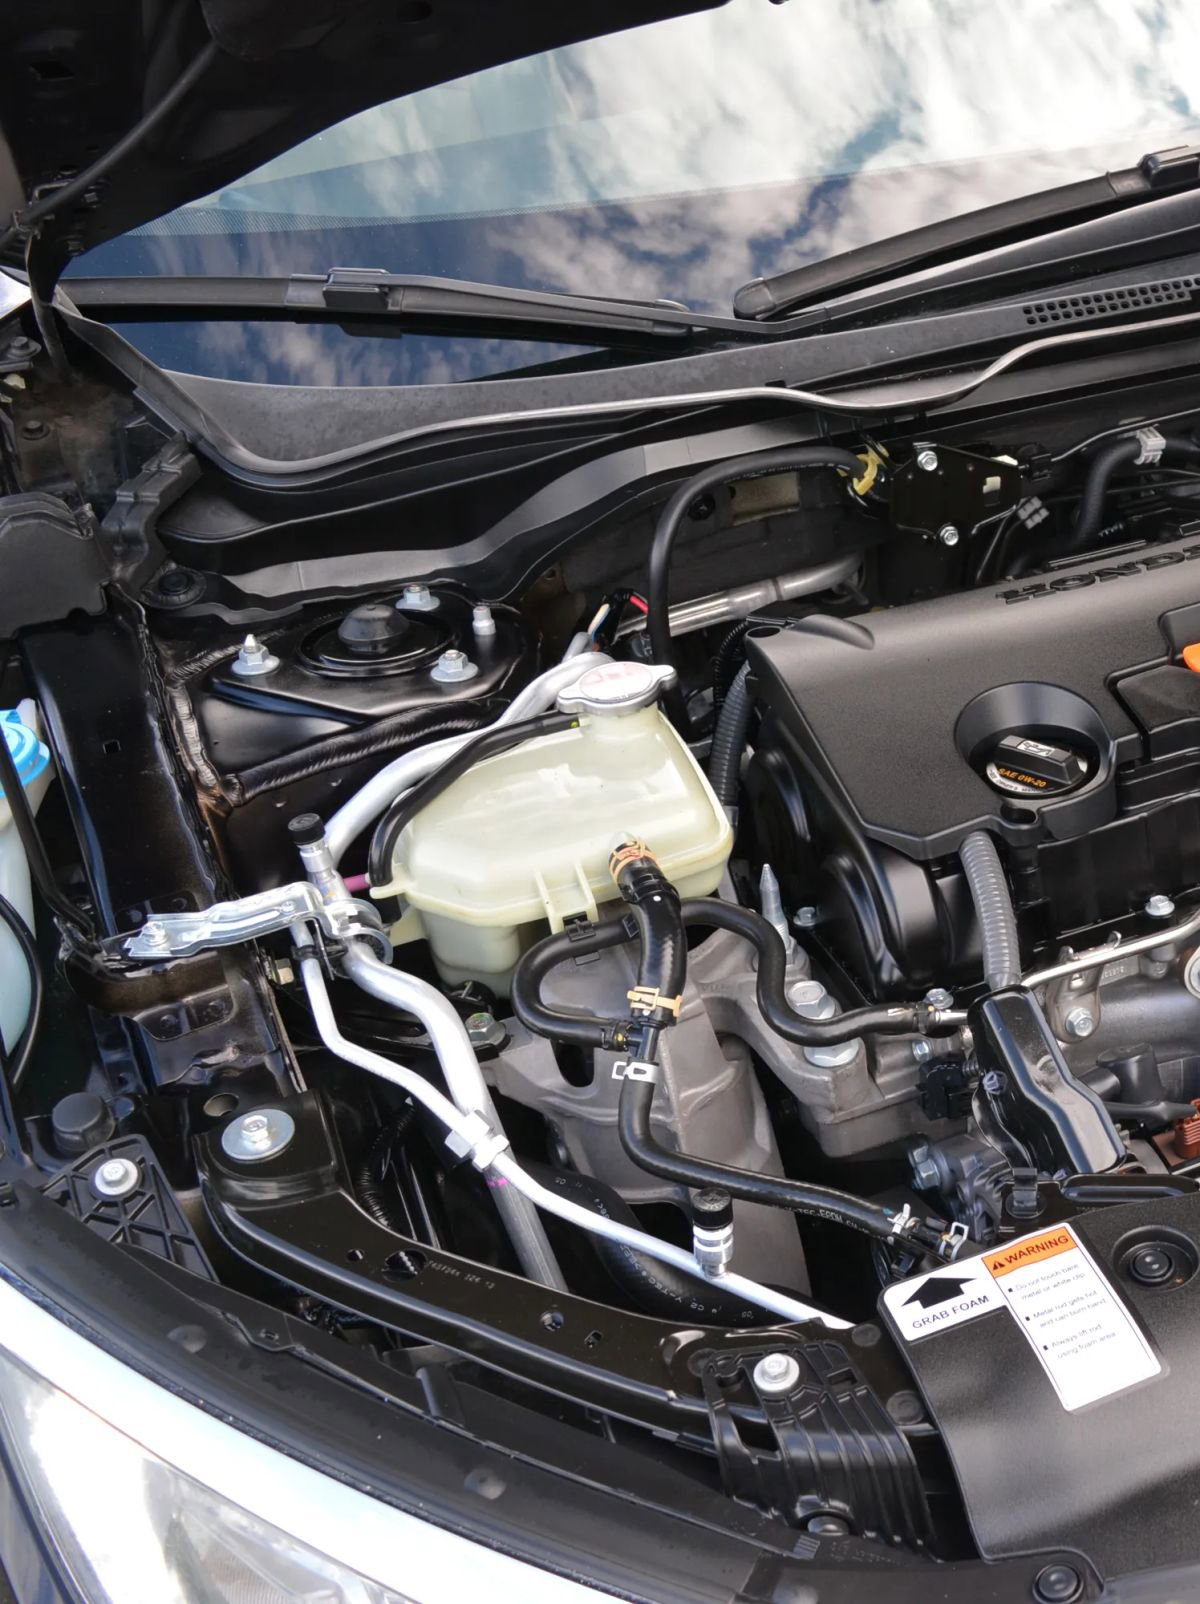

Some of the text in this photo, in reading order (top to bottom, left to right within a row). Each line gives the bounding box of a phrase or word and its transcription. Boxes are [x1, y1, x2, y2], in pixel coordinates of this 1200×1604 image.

[998, 768, 1018, 780] SAE
[1018, 774, 1047, 788] 0W-20
[1004, 1235, 1069, 1264] WARNING
[1040, 1271, 1061, 1284] touch
[1021, 1289, 1042, 1300] metal
[912, 1295, 989, 1329] GRAB FOAM
[1033, 1306, 1054, 1318] Metal
[1052, 1335, 1078, 1348] Always
